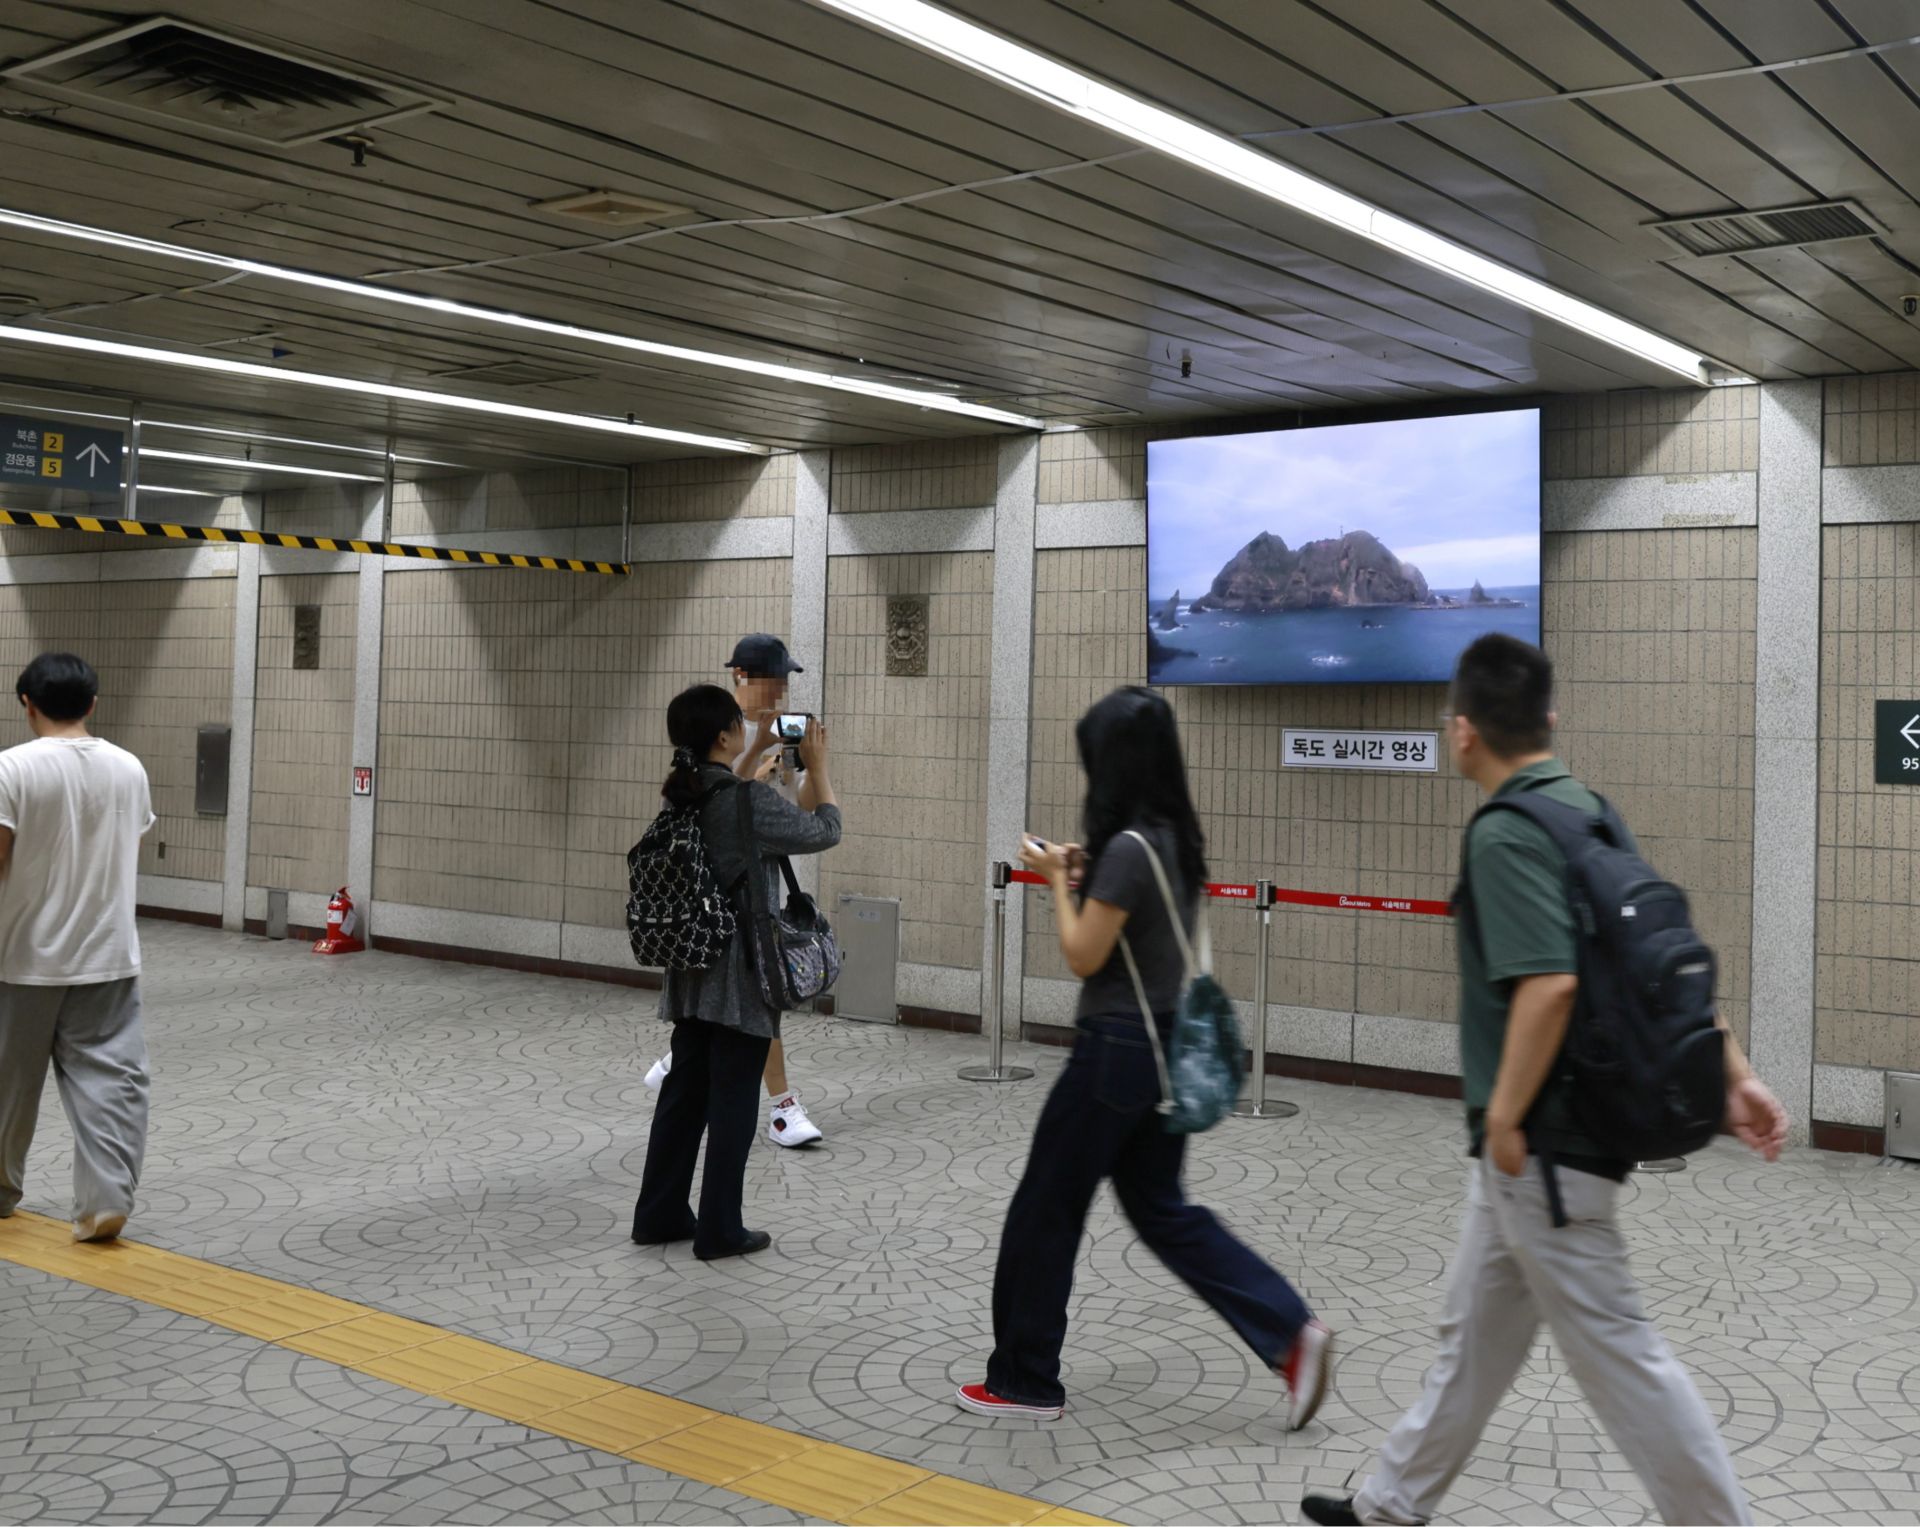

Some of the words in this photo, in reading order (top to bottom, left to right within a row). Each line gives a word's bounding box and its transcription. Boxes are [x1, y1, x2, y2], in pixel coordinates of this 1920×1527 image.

[16, 429, 38, 442] 북촌
[48, 436, 57, 449] 2
[5, 453, 36, 467] 경운동
[48, 461, 57, 474] 5
[1292, 738, 1326, 758] 독도
[1332, 739, 1385, 760] 실시간
[1391, 740, 1427, 762] 영상
